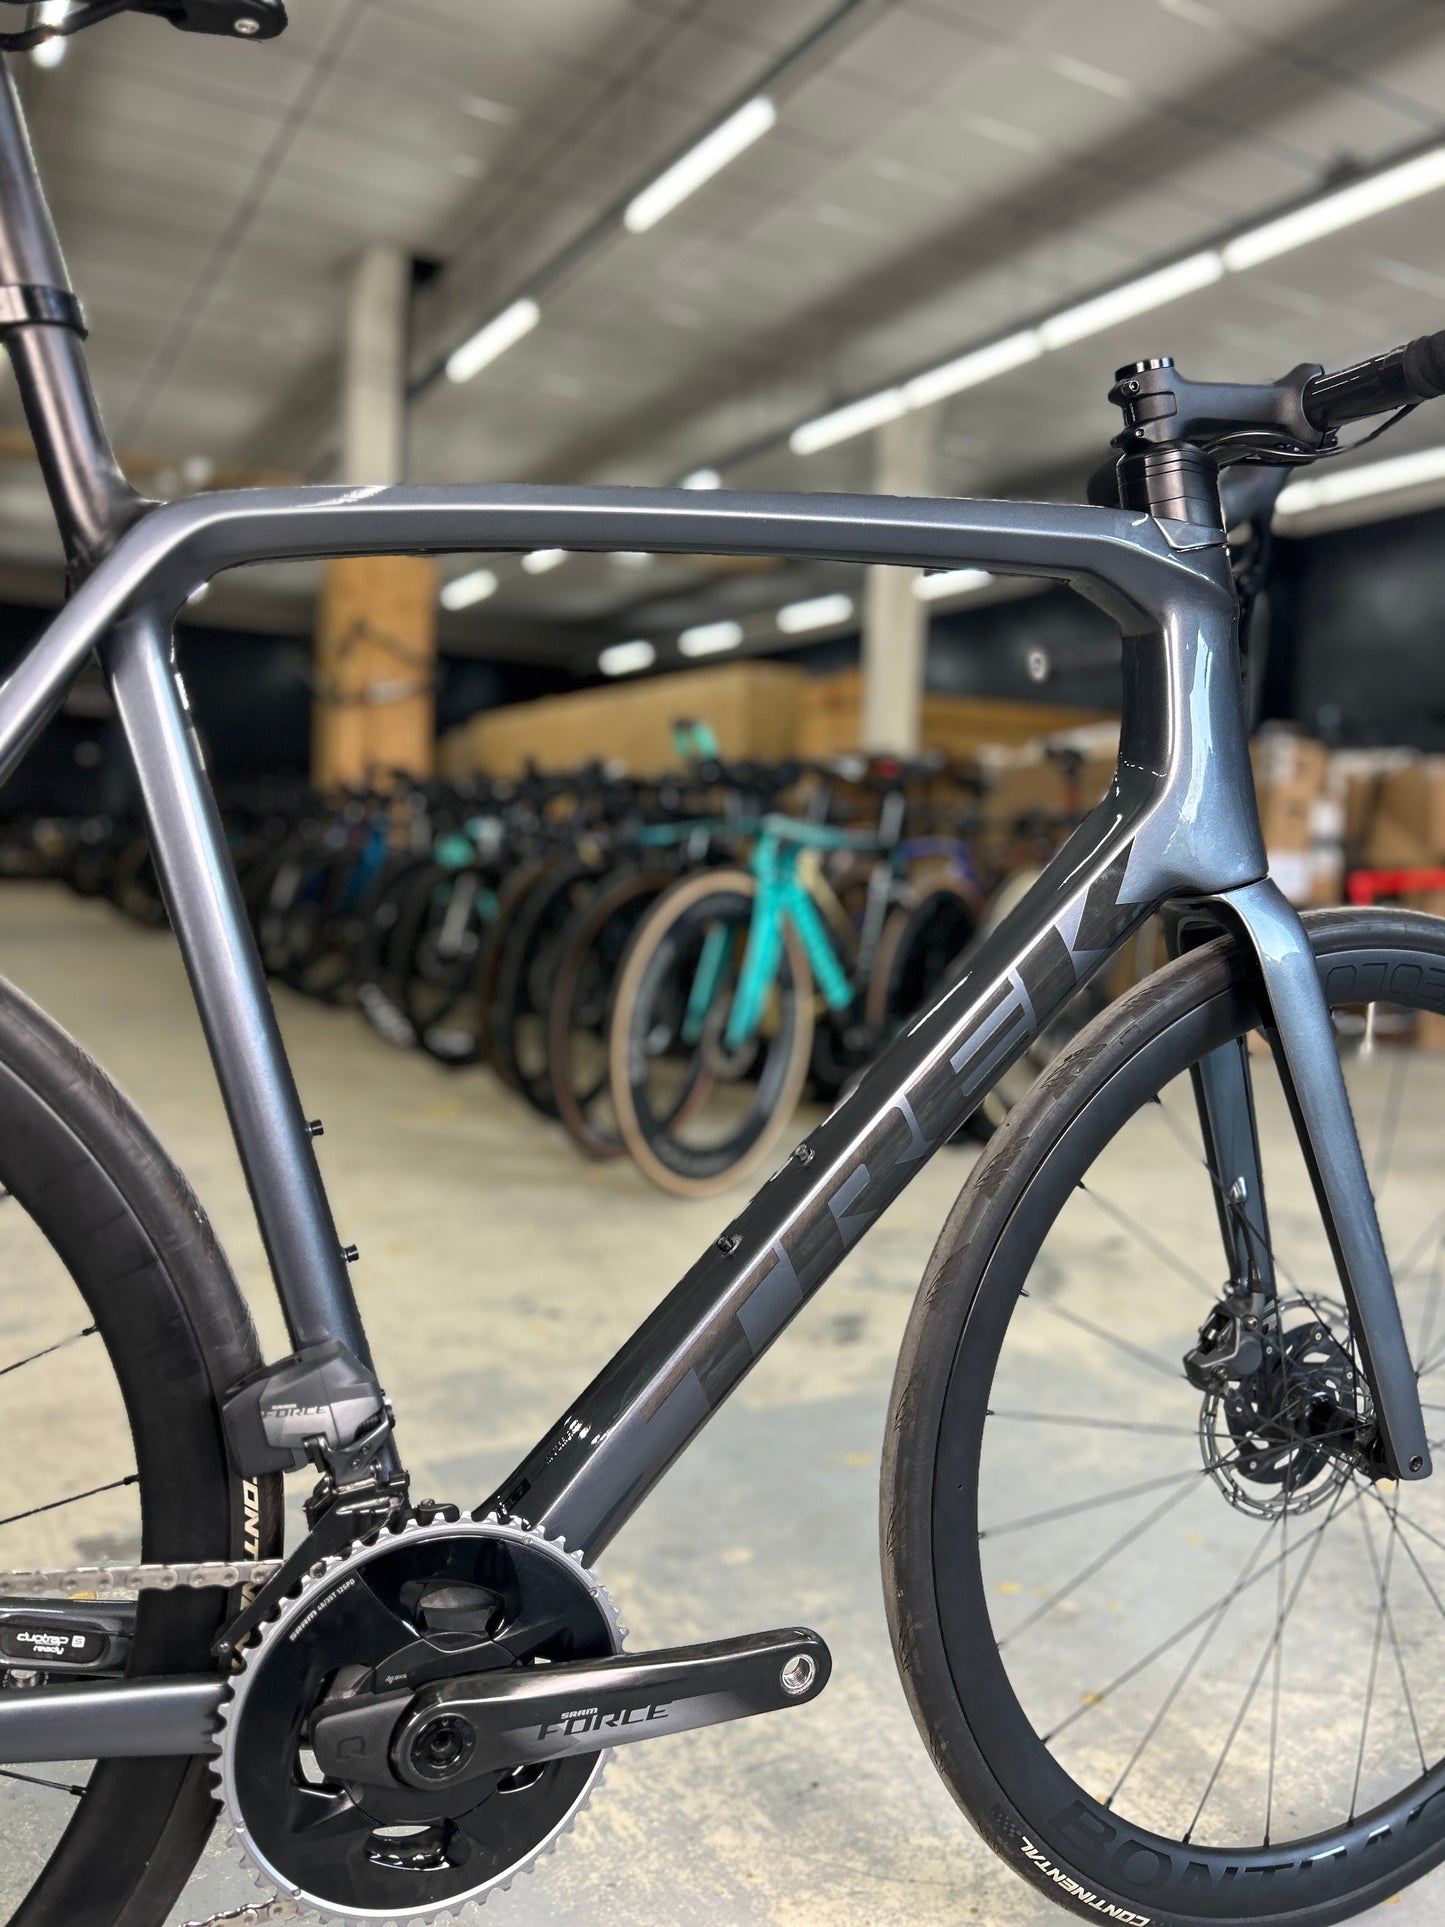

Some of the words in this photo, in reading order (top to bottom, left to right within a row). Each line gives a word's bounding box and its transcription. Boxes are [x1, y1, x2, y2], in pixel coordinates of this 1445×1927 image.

[641, 838, 1134, 1420] TREK
[261, 1405, 329, 1419] FORCE
[289, 1609, 318, 1641] SRAM
[33, 1645, 65, 1655] ready
[537, 1702, 671, 1740] FORCE
[561, 1707, 598, 1720] SRAM
[1018, 1835, 1151, 1927] CONTINENTAL
